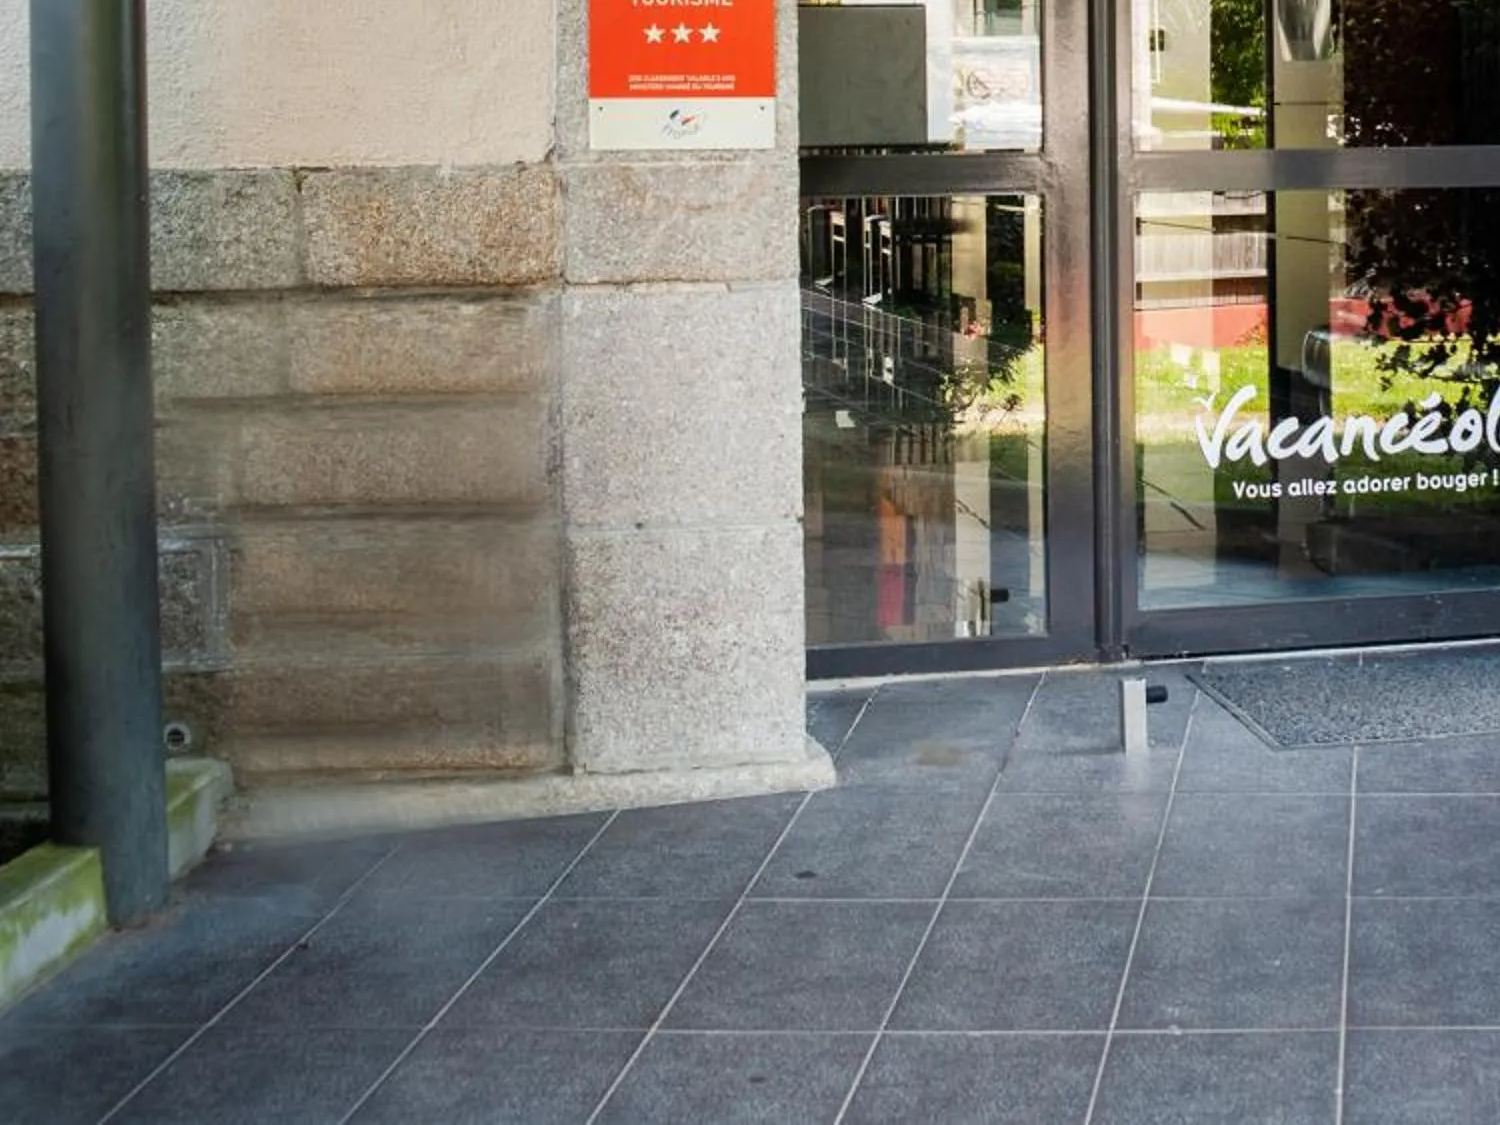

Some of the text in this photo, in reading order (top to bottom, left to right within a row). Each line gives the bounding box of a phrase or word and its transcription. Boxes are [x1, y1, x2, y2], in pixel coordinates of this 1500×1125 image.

[1232, 469, 1499, 499] Vous allez adorer bouger !
